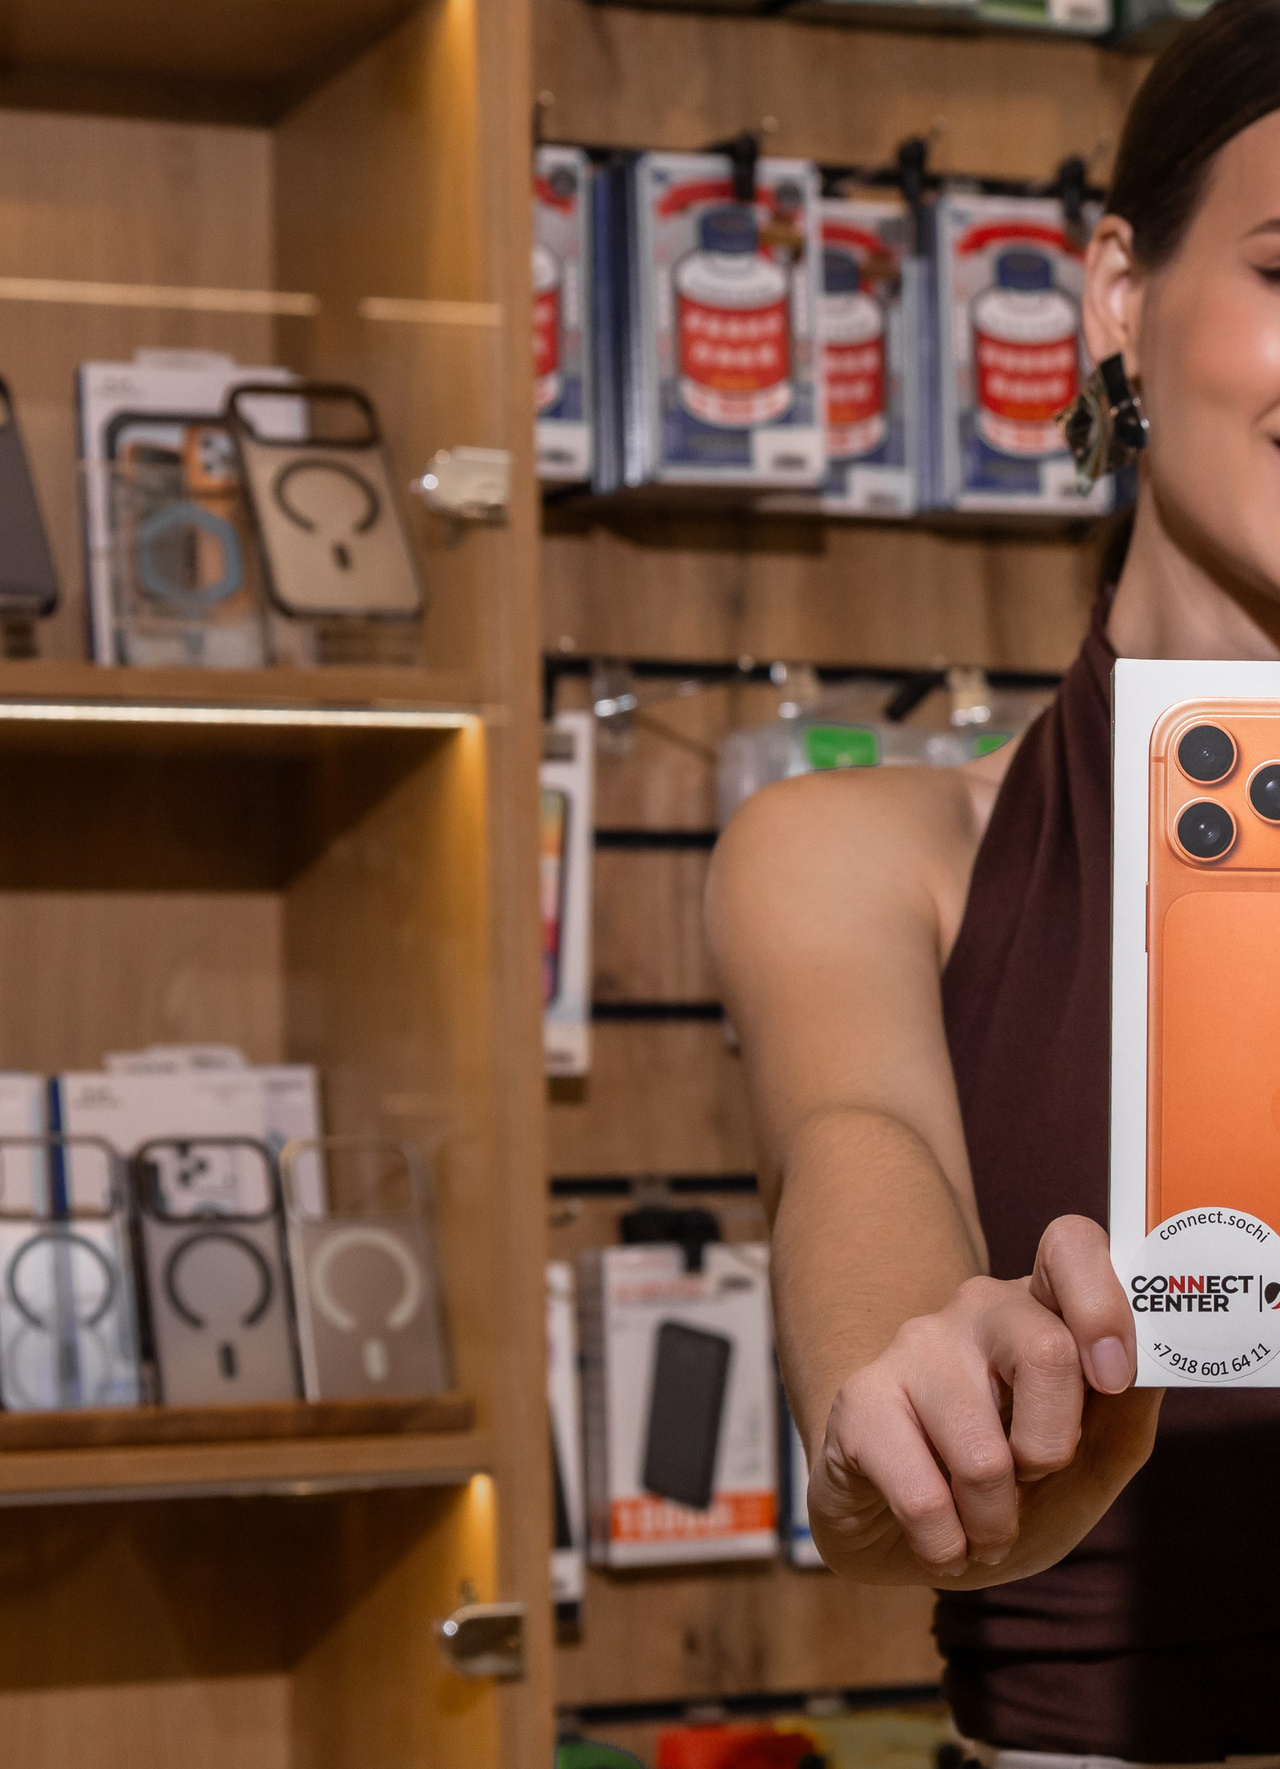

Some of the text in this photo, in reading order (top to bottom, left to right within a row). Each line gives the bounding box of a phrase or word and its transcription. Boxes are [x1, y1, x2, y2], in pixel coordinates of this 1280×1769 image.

[1159, 1210, 1271, 1243] connect.sochi
[1131, 1275, 1254, 1294] CONNECT
[1132, 1294, 1230, 1313] CENTER
[1153, 1342, 1271, 1376] +7 918 601 64 11
